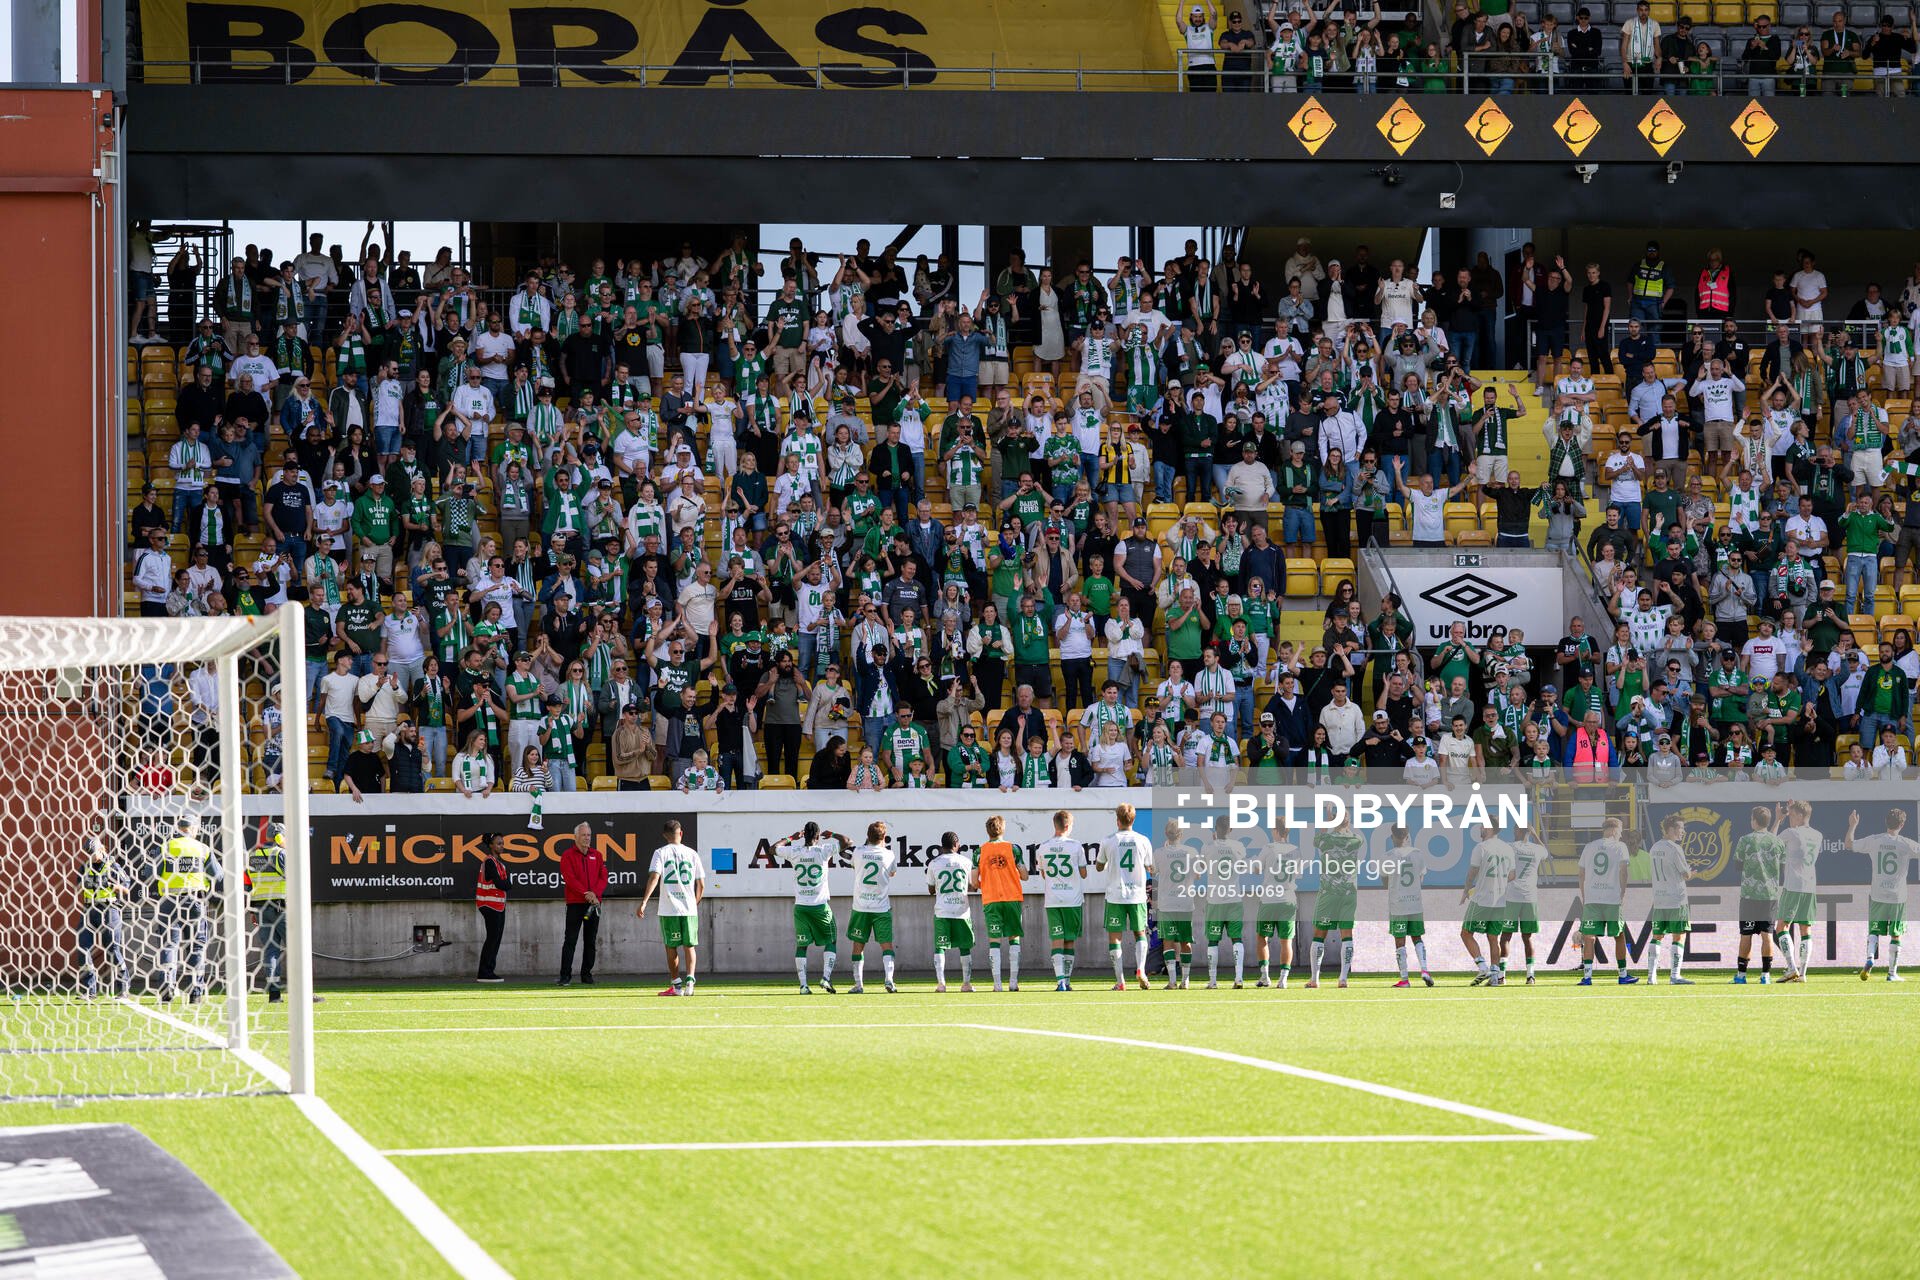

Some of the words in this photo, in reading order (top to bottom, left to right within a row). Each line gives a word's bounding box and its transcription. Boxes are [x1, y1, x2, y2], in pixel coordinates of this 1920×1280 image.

[186, 0, 939, 88] BORÅS
[663, 860, 693, 885] 26
[1044, 854, 1073, 878] 33
[1119, 848, 1134, 872] 4
[1518, 857, 1533, 880] 7
[1593, 851, 1609, 876] 9
[1653, 858, 1668, 882] 11
[1877, 851, 1898, 876] 16
[331, 875, 454, 887] www.mickson.com
[795, 863, 823, 887] 29
[862, 861, 879, 886] 2
[938, 869, 964, 894] 28
[1400, 863, 1414, 888] 5
